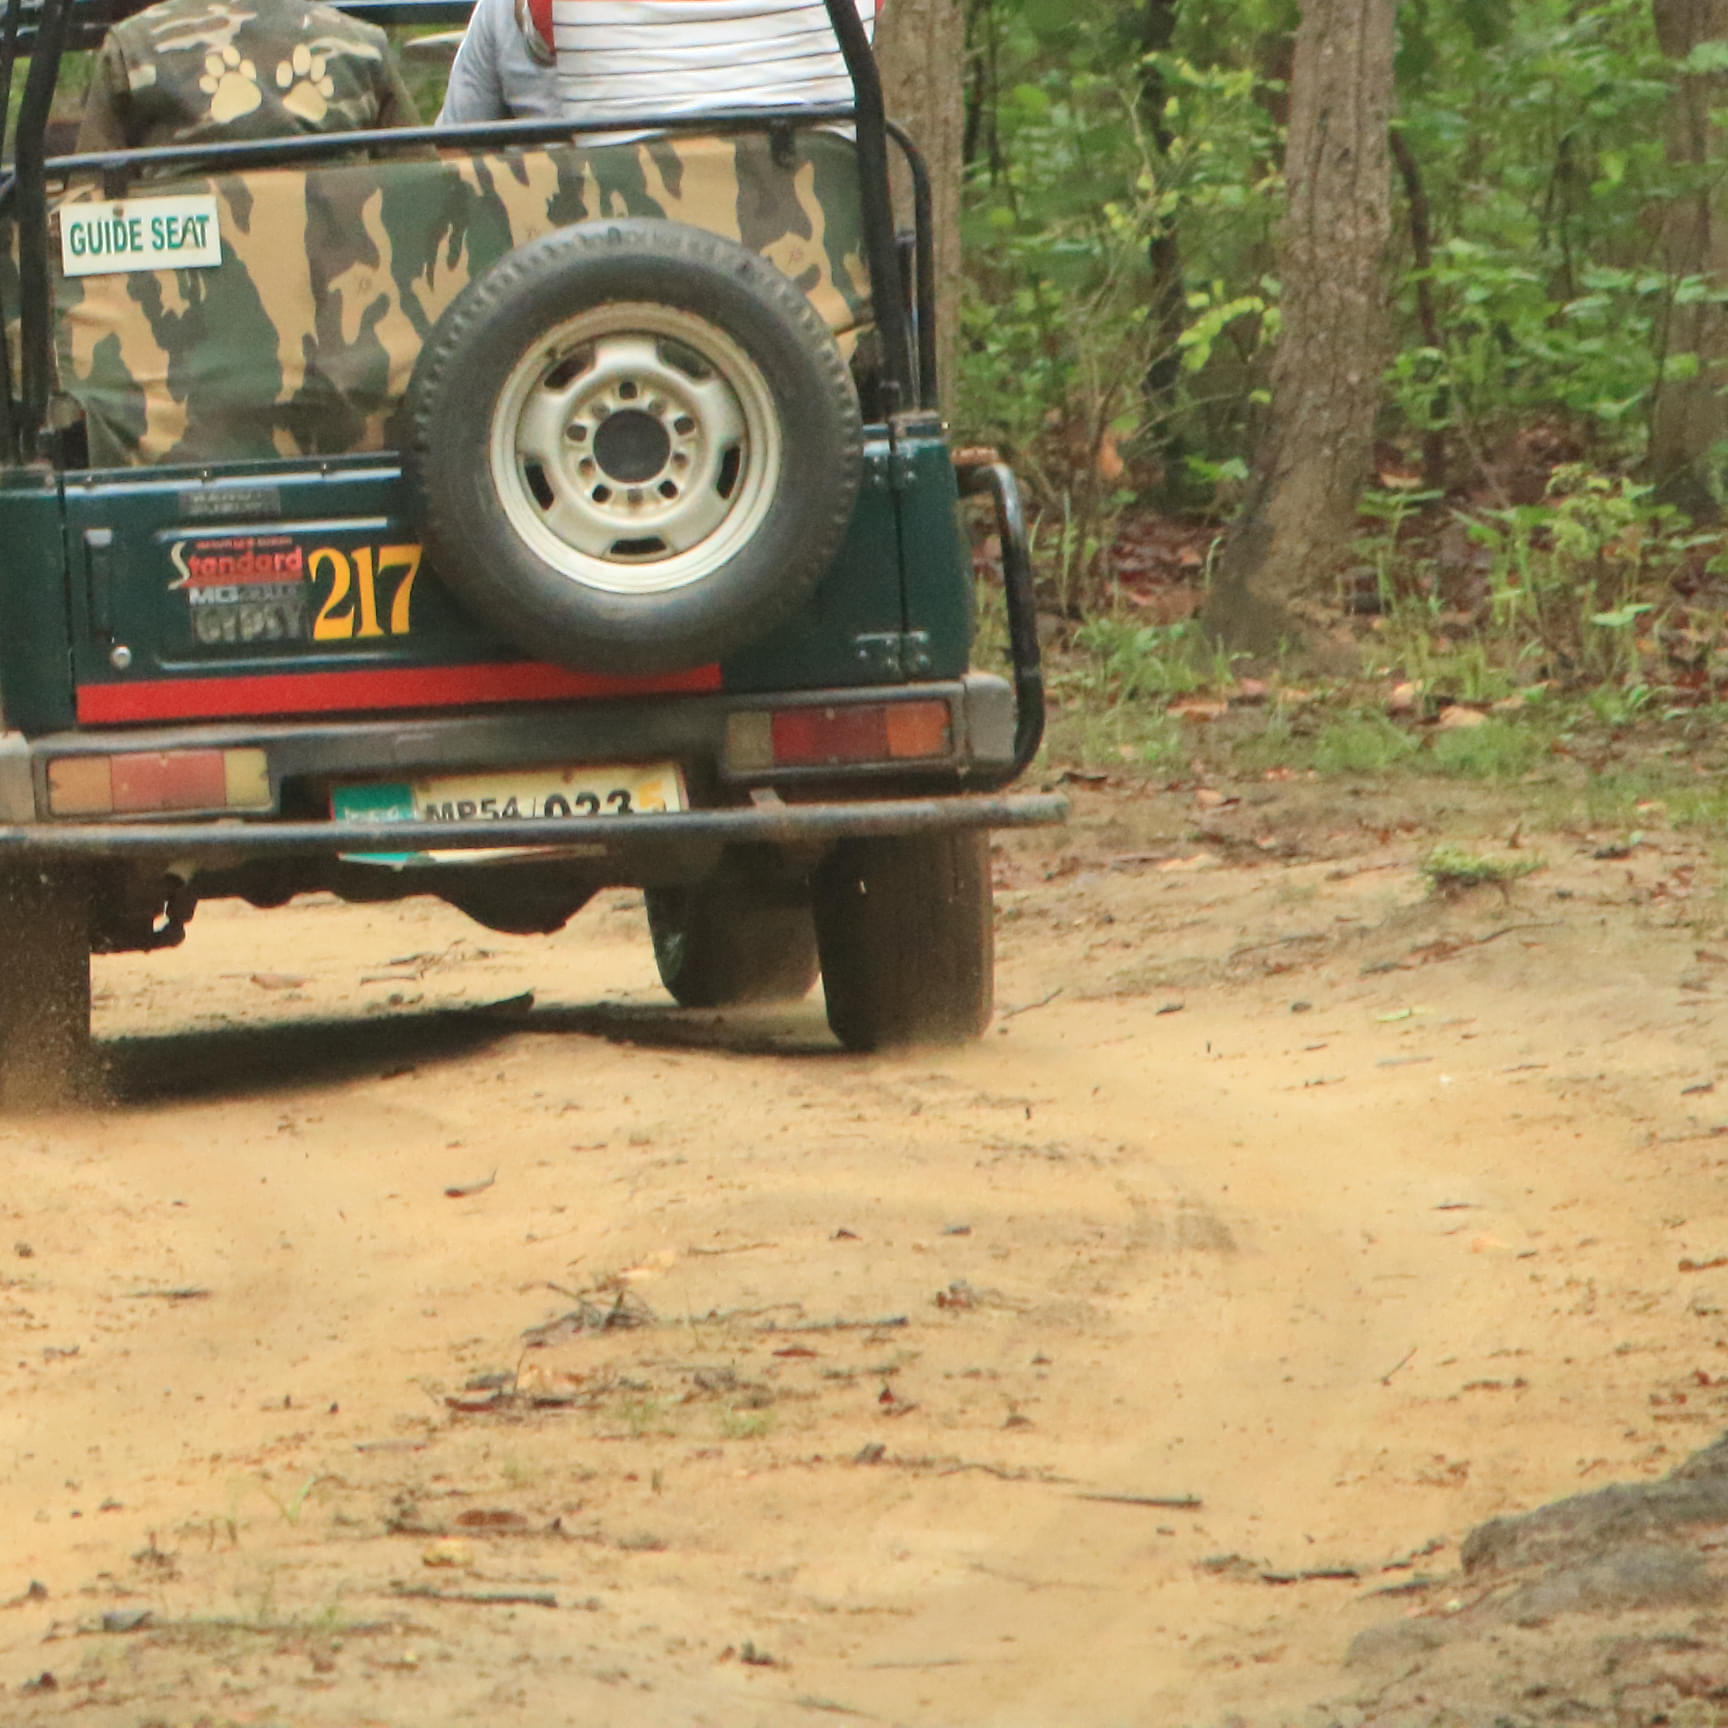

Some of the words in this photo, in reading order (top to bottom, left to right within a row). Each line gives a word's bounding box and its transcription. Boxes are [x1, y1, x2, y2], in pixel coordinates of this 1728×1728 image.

[69, 218, 144, 256] GUIDE
[151, 214, 210, 251] SEAT
[168, 541, 303, 590] Standard
[307, 542, 423, 641] 217
